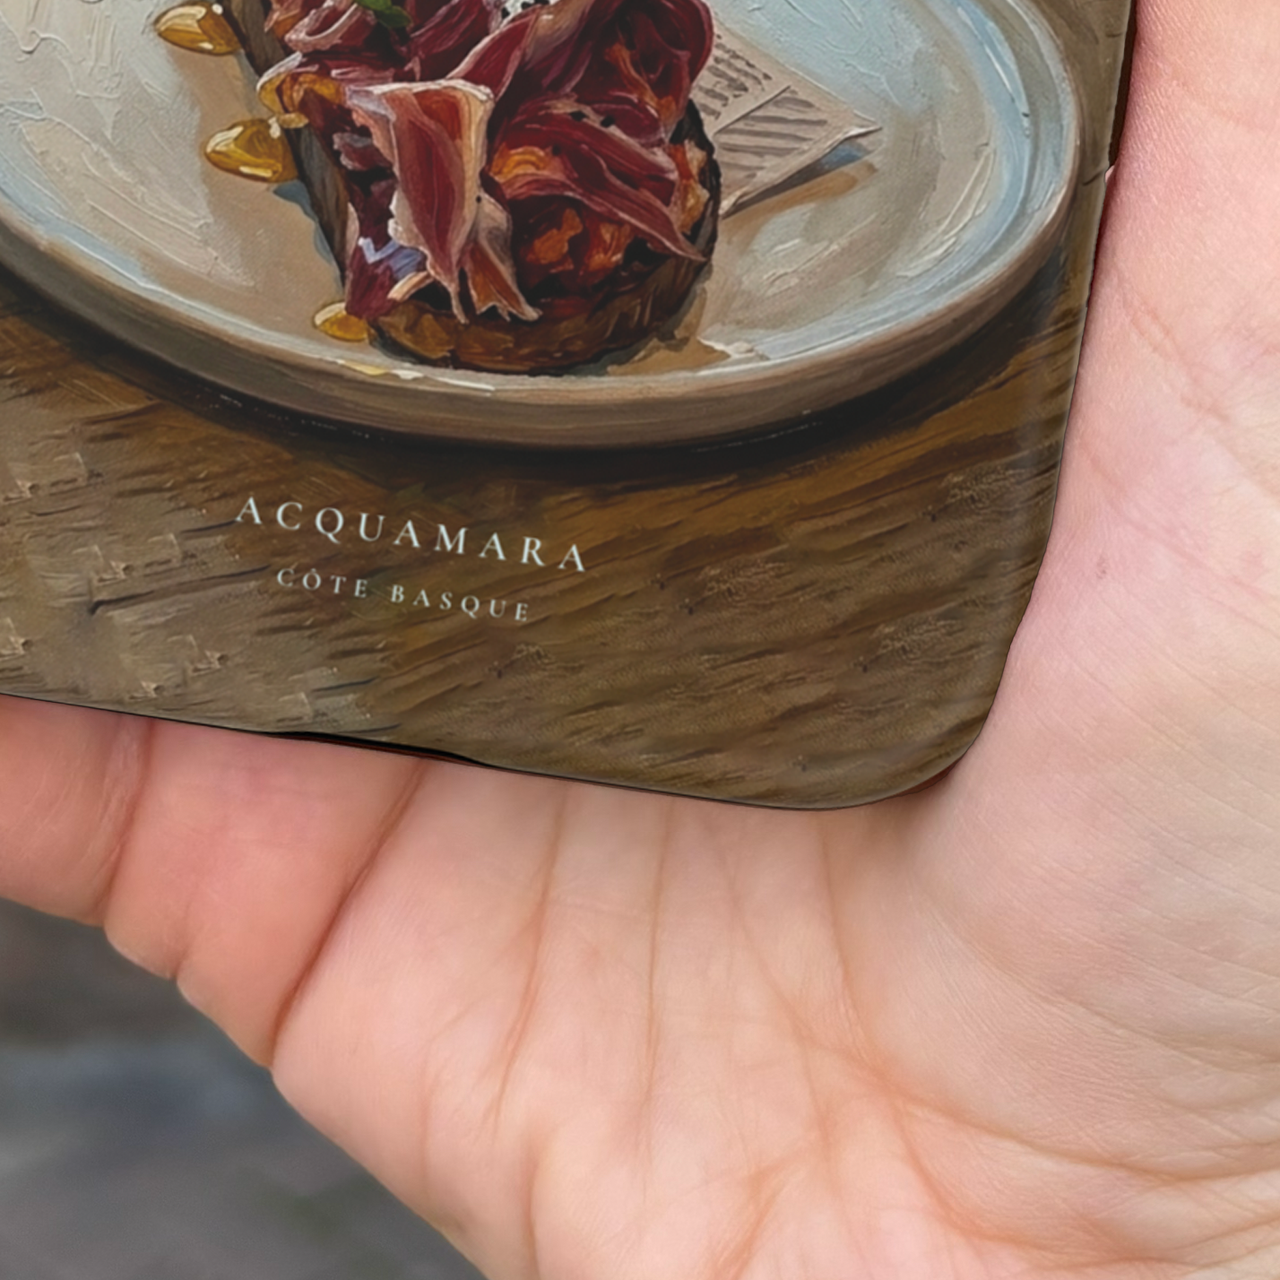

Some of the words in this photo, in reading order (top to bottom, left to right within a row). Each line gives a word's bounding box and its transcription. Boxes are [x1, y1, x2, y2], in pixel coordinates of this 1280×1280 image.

[235, 495, 586, 573] ACQUAMARA
[276, 567, 368, 599] CÔTE
[391, 583, 530, 622] BASQUE
